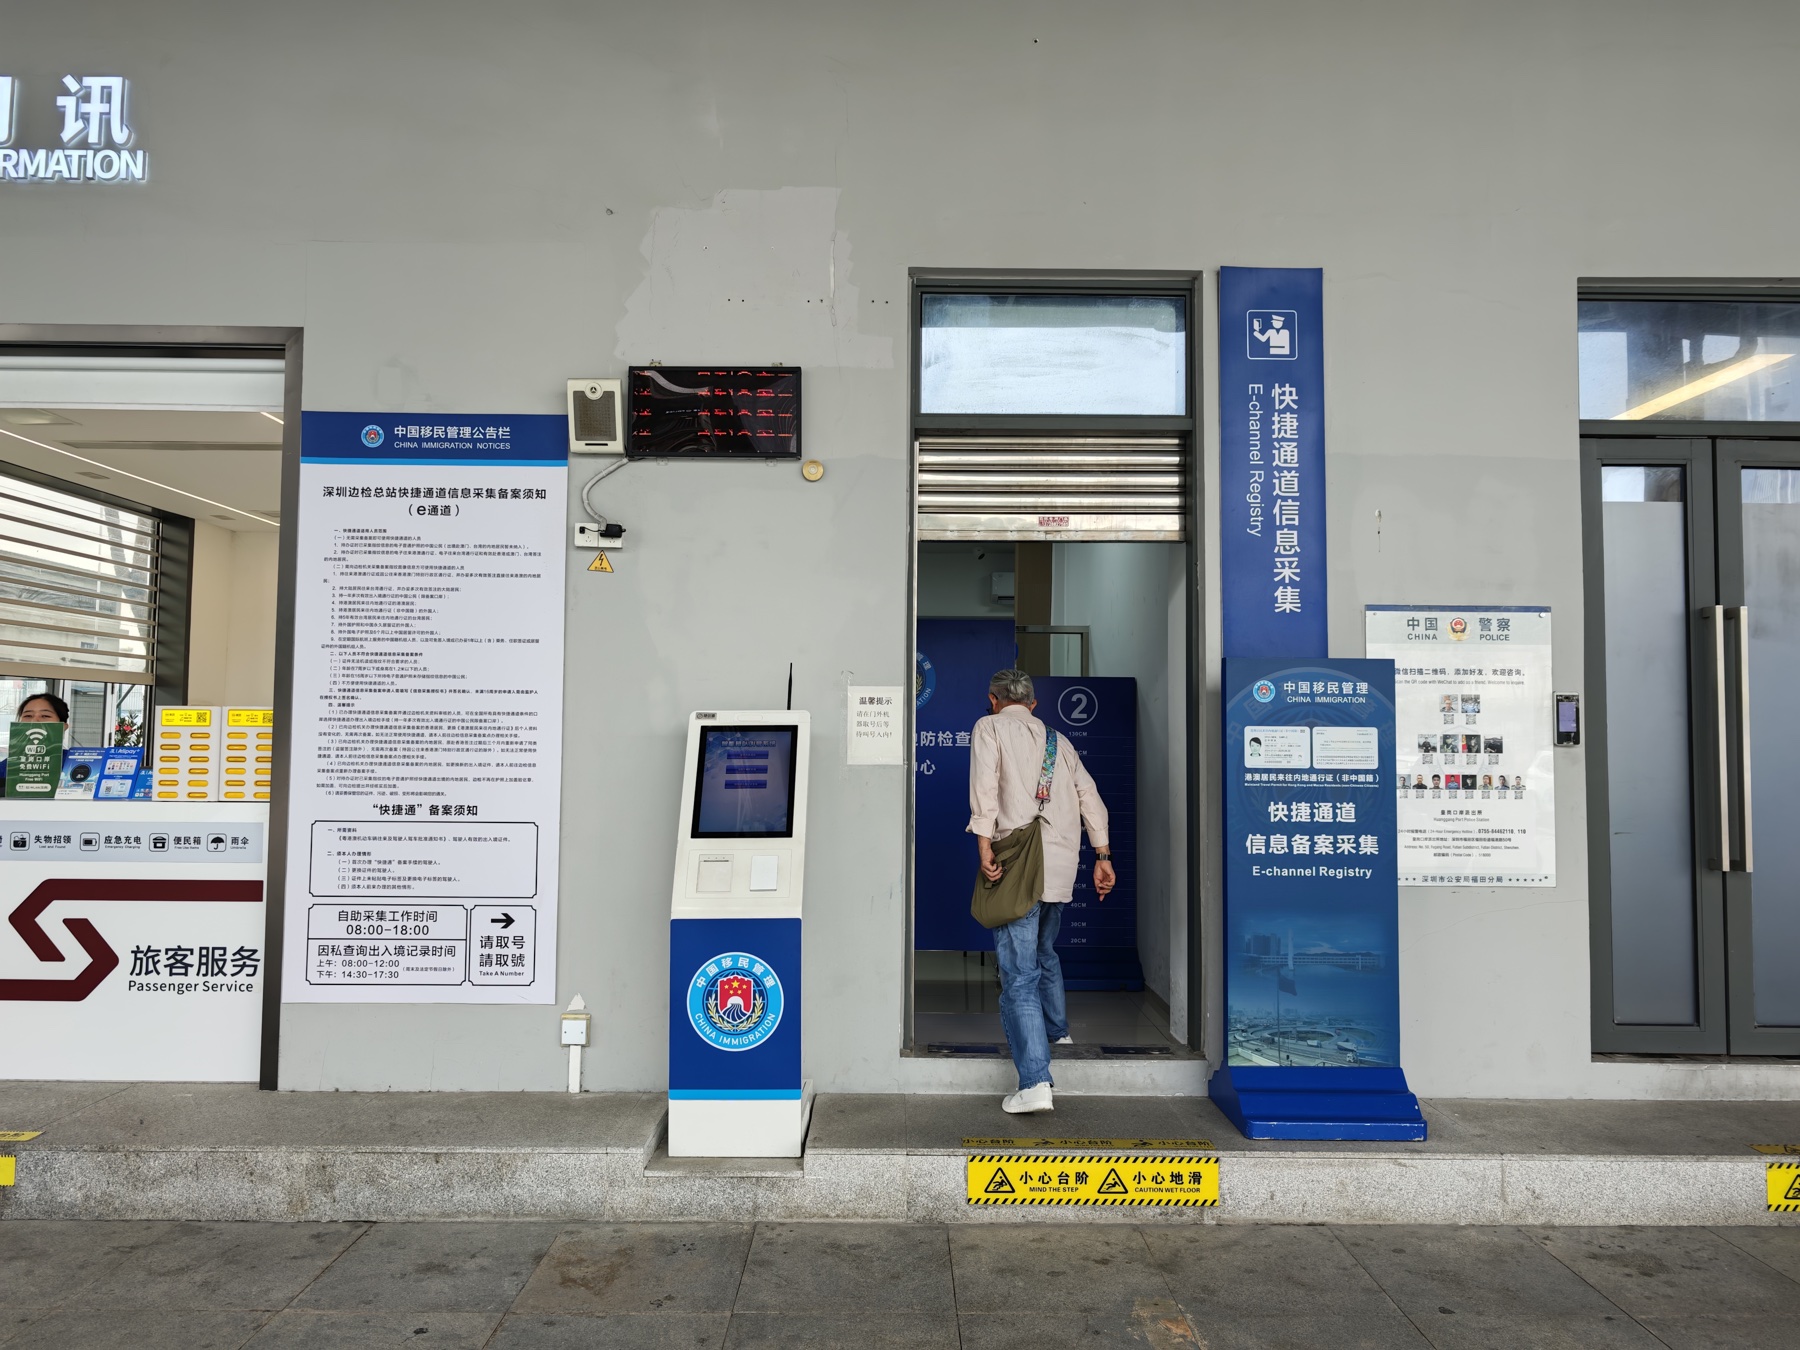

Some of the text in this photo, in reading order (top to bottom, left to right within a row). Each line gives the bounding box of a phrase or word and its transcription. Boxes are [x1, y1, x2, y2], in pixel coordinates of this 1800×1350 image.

[394, 425, 511, 440] 中国移民管理公告栏
[394, 442, 419, 450] CHINA
[421, 442, 473, 450] IMMIGRATION
[1246, 384, 1264, 537] E-channel Registry
[322, 486, 547, 500] 深圳边检总站快捷通道信息采集备案须知
[1271, 383, 1301, 614] 快捷通道信息采集
[1407, 617, 1511, 632] 中国 警察
[1407, 633, 1510, 641] CHINA POLICE
[1283, 681, 1369, 694] 中国移民管理
[858, 696, 893, 705] 温馨提示
[1070, 693, 1088, 719] 2
[915, 731, 971, 747] 防检查
[1244, 773, 1380, 783] 港澳居民来往内地通行证（非中国籍）
[1268, 801, 1357, 823] 快捷通道
[34, 834, 72, 844] 失物招领
[104, 835, 142, 845] 应急充电
[173, 836, 201, 845] 便民箱
[231, 836, 249, 845] 雨伞
[1245, 833, 1379, 856] 信息备案采集
[1252, 866, 1372, 879] E-channel Registry
[1421, 875, 1504, 885] 深圳市公安局福田分局
[338, 911, 438, 922] 自助采集工作时间
[346, 925, 430, 936] 08:00-18:00
[479, 935, 525, 949] 请取号
[318, 945, 457, 958] 因私查询出入境记录时间
[129, 945, 261, 977] 旅客服务
[479, 953, 525, 967] 請取號
[696, 957, 776, 988] 中国移民管理
[128, 980, 253, 995] Passenger Service
[694, 1012, 776, 1045] CHINA IMMIGRATION
[1019, 1171, 1090, 1186] 小心台阶
[1132, 1171, 1203, 1186] 小心地滑
